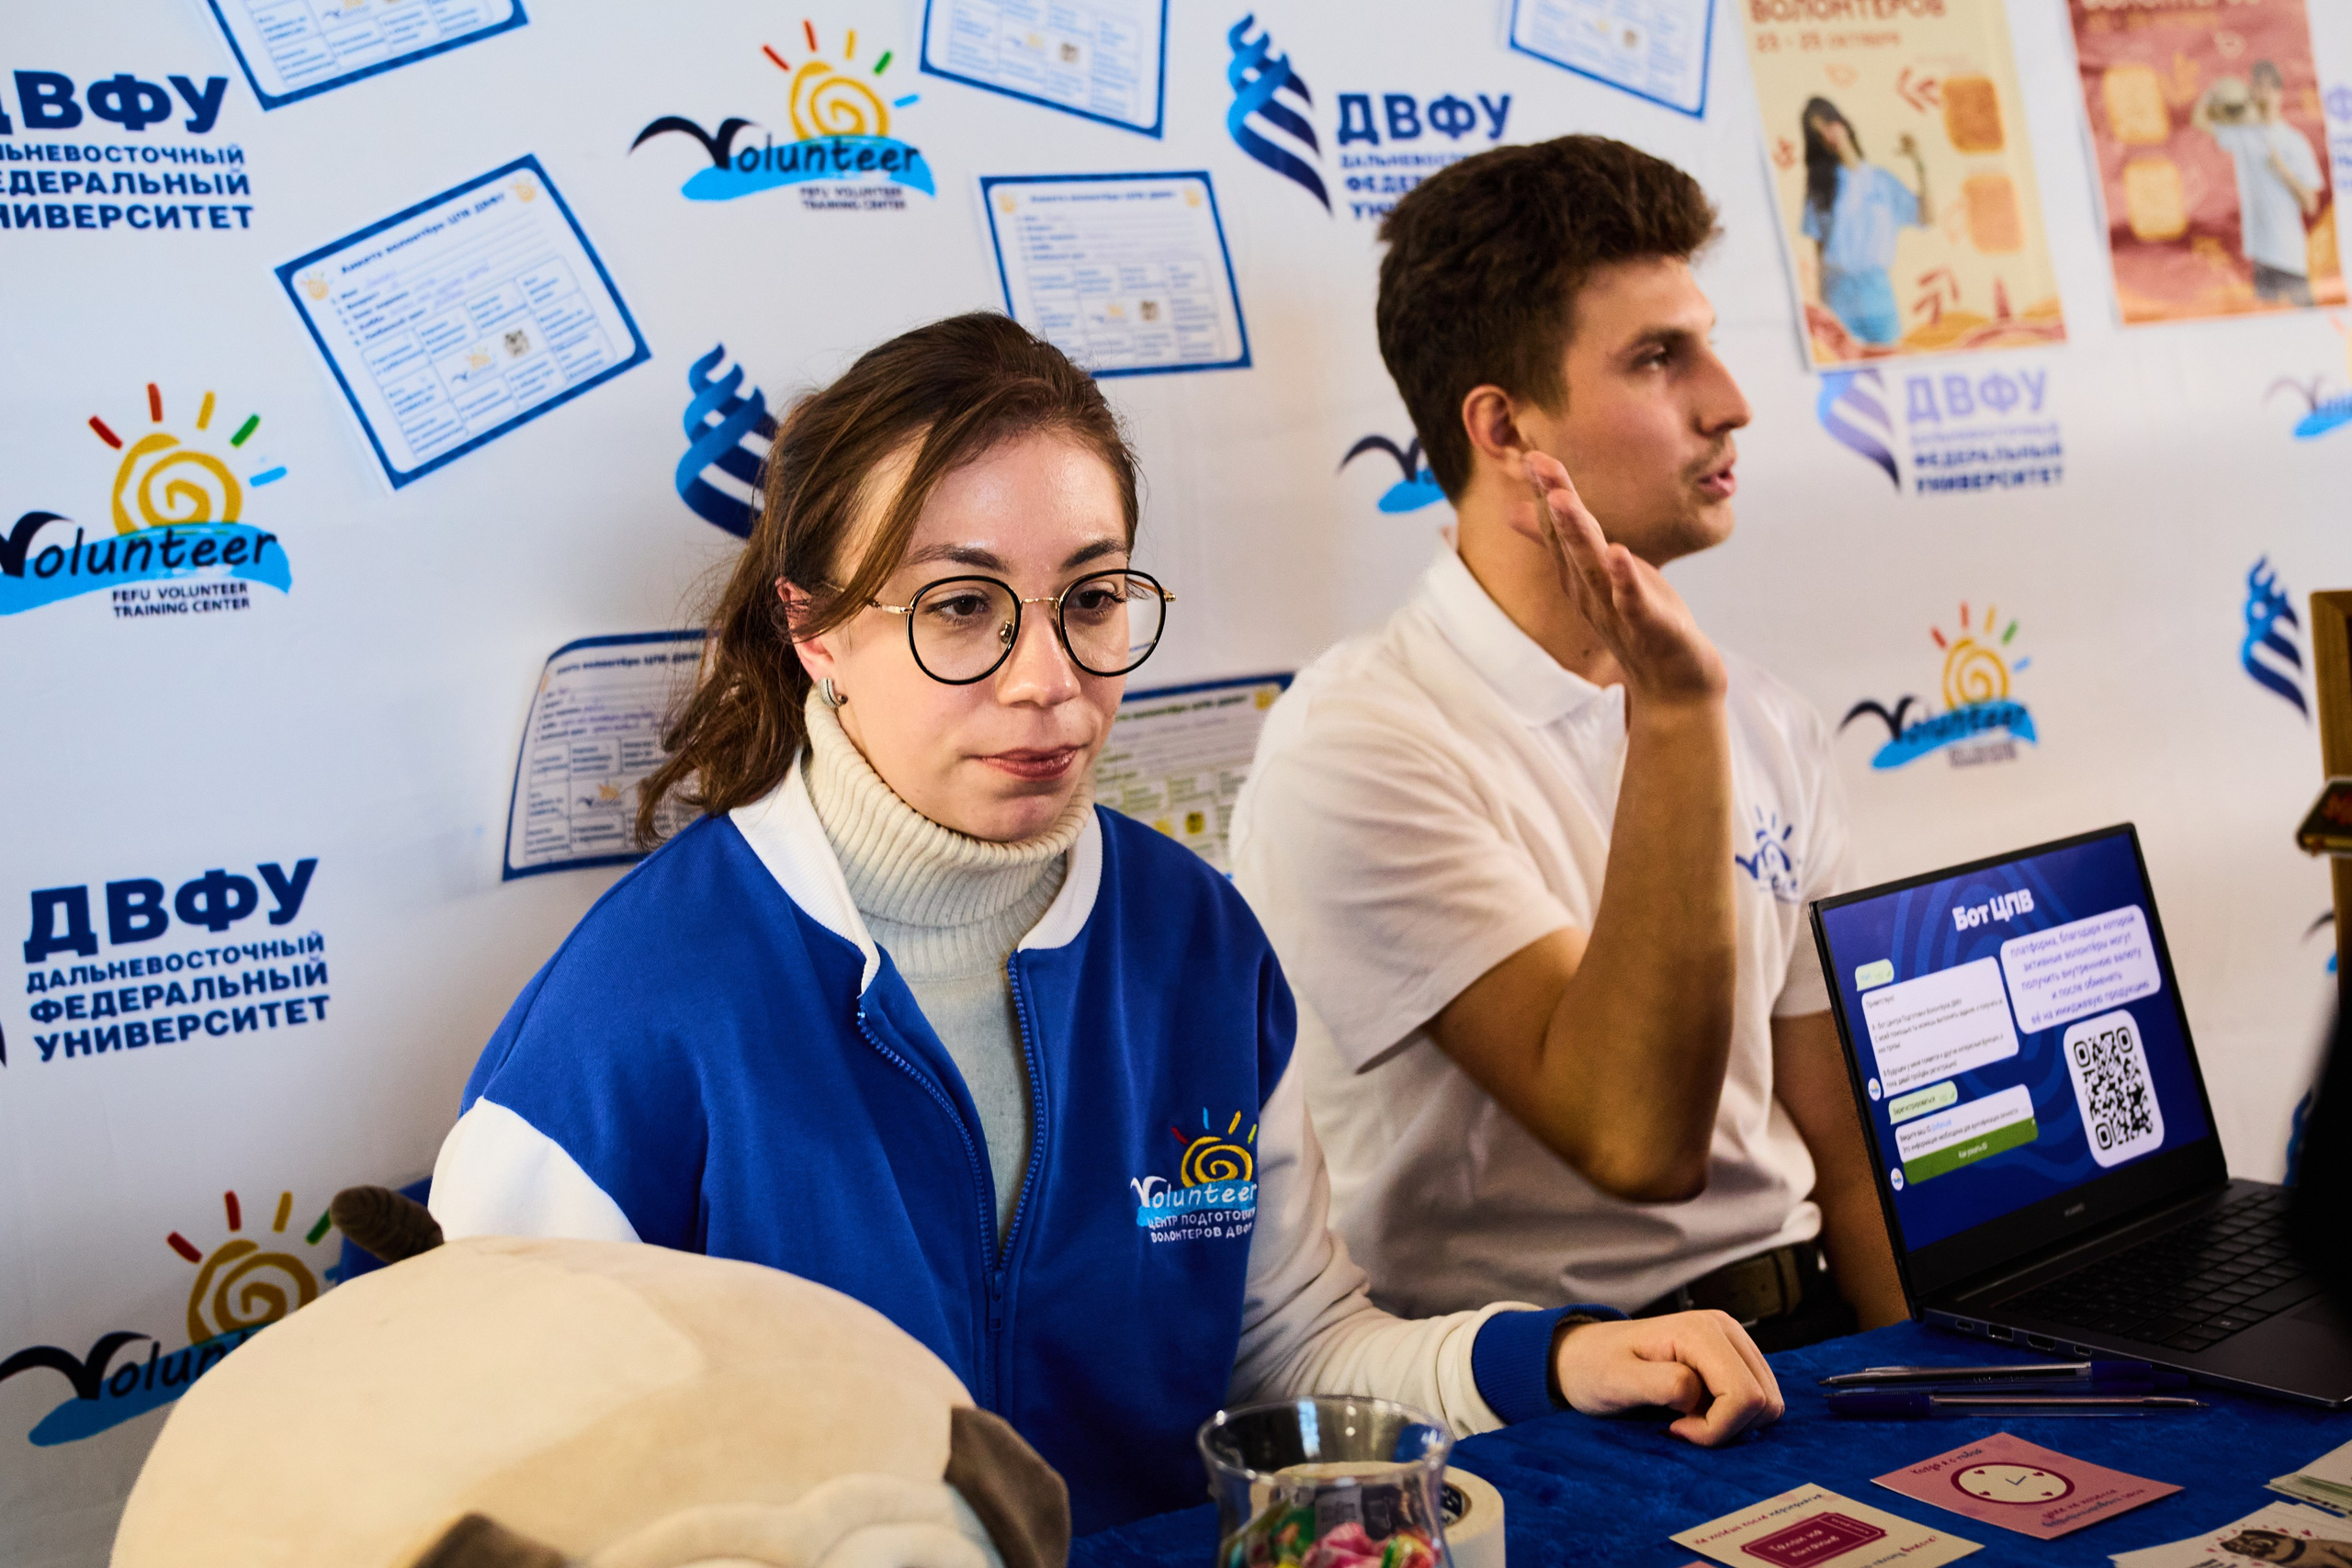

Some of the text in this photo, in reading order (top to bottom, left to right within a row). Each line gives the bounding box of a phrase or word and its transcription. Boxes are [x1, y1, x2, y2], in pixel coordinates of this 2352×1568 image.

[0, 71, 228, 134] ВФУ
[1338, 94, 1512, 146] ДВФУ
[0, 143, 244, 164] ЬНЕВОСТОЧНЫЙ
[628, 115, 919, 173] Volunteer
[0, 168, 250, 196] ДЕРАЛЬНЫЙ
[1906, 370, 2046, 423] ДВФУ
[0, 512, 277, 579] Volunteer
[112, 582, 248, 603] FEFU VOLUNTEER
[114, 597, 250, 619] TRAINING CENTER
[24, 858, 318, 964] ДВФУ
[1952, 888, 2035, 931] Бот ЦПВ
[2103, 914, 2134, 931] которой
[2109, 932, 2131, 947] могут
[27, 931, 324, 994] ДАЛЬНЕВОСТОЧНЫЙ
[2021, 972, 2060, 992] получить
[2113, 947, 2142, 964] валюту
[2059, 983, 2082, 997] после
[2083, 967, 2121, 989] обменять
[29, 957, 328, 1023] ФЕДЕРАЛЬНЫЙ
[34, 995, 330, 1063] УНИВЕРСИТЕТ
[1130, 1176, 1257, 1208] Volunteer
[1147, 1214, 1178, 1230] ЦЕНТР
[1151, 1226, 1222, 1243] ВОЛОНТЕРОВ
[0, 1331, 248, 1400] Volun
[1807, 1529, 1825, 1540] на
